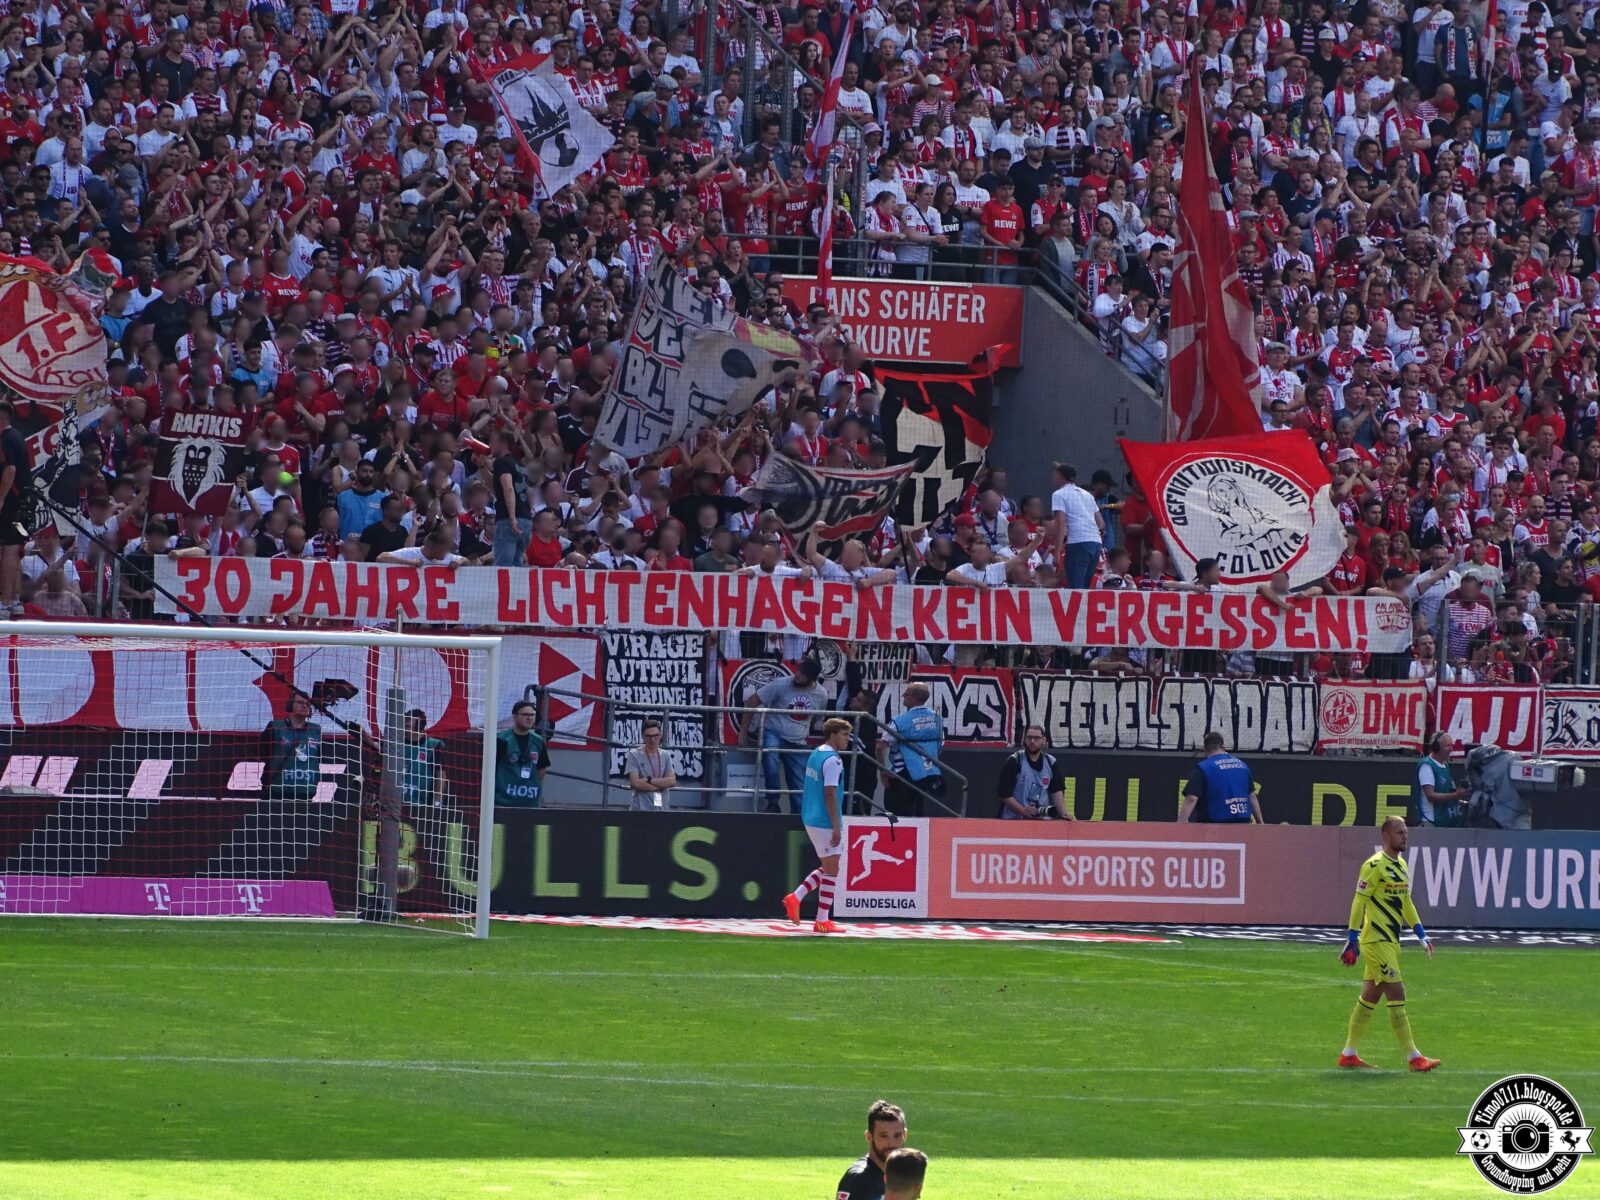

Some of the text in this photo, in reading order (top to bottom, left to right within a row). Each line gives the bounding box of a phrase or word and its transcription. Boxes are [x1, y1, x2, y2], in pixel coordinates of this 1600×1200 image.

[994, 219, 1018, 231] REWE
[879, 284, 986, 324] SCHÄFER
[170, 412, 243, 438] RAFIKIS
[1166, 458, 1308, 526] DEFINITIONSMACHT
[177, 557, 251, 616] 30
[270, 558, 460, 622] JAHRE
[1048, 590, 1369, 653] VERGESSEN!
[603, 633, 703, 658] VIRAGE
[606, 659, 702, 684] AUTEUIL
[1362, 692, 1423, 738] DMC
[1449, 697, 1532, 747] AJJ
[506, 783, 539, 800] HOST
[970, 853, 1227, 890] URBAN SPORTS CLUB
[845, 898, 916, 909] BUNDESLIGA
